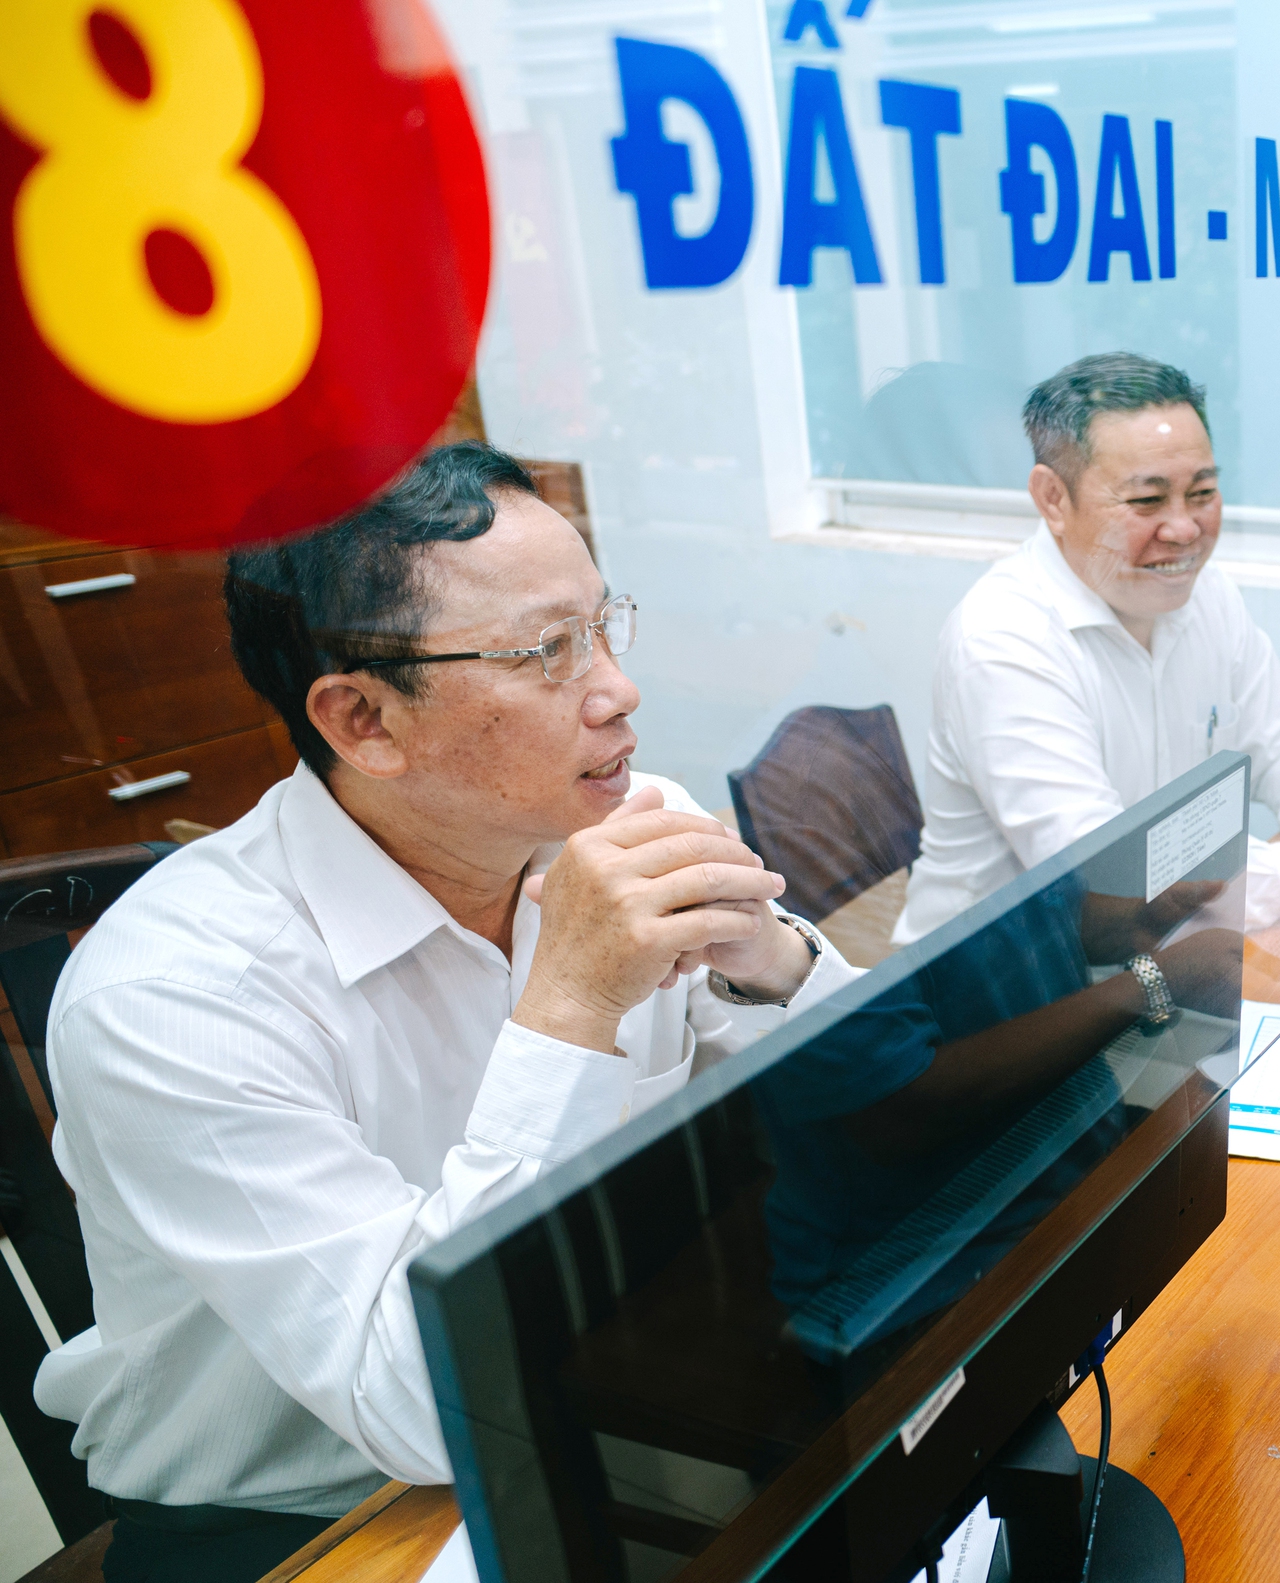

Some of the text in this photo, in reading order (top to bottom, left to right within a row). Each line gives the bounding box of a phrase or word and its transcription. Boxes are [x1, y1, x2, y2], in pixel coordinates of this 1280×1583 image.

[0, 0, 322, 425] 8
[609, 0, 963, 291] ĐẤT
[999, 96, 1177, 285] ĐAI
